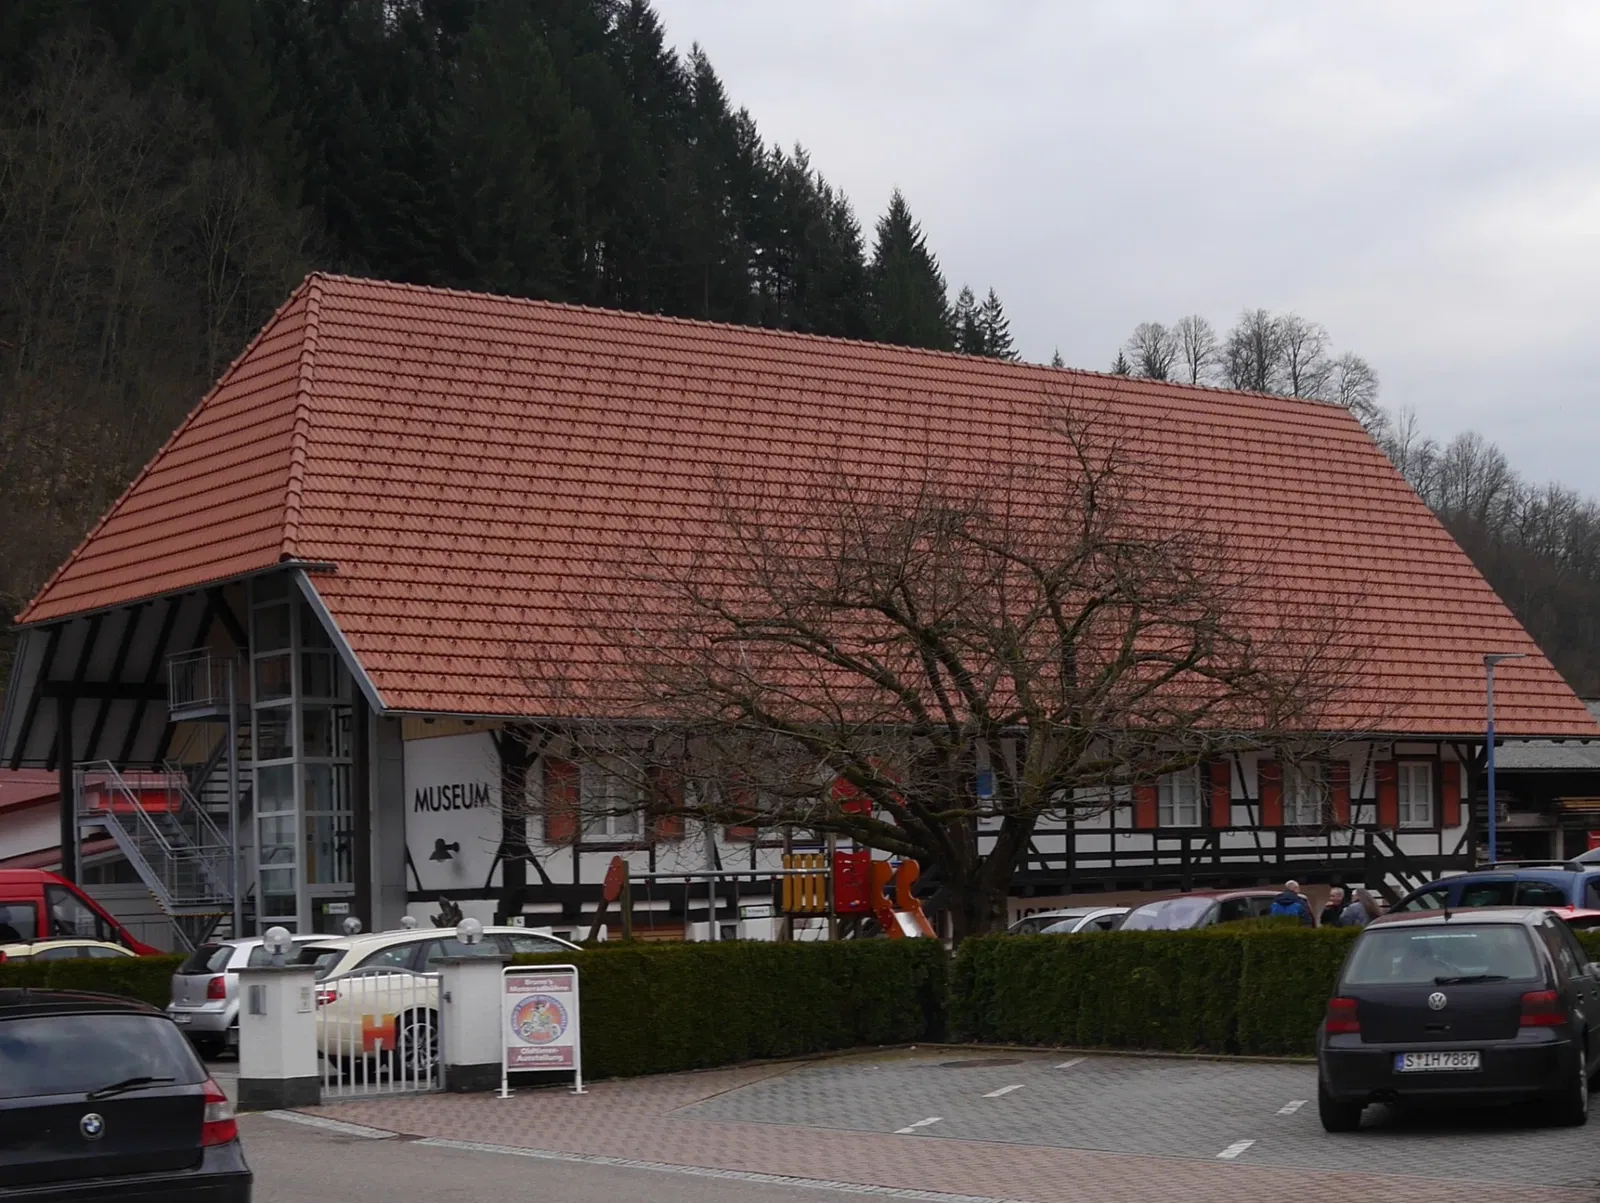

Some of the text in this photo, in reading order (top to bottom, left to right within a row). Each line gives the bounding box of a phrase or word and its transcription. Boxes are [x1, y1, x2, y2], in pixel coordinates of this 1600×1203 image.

[414, 782, 490, 813] MUSEUM
[1405, 1052, 1477, 1067] S IH 7887
